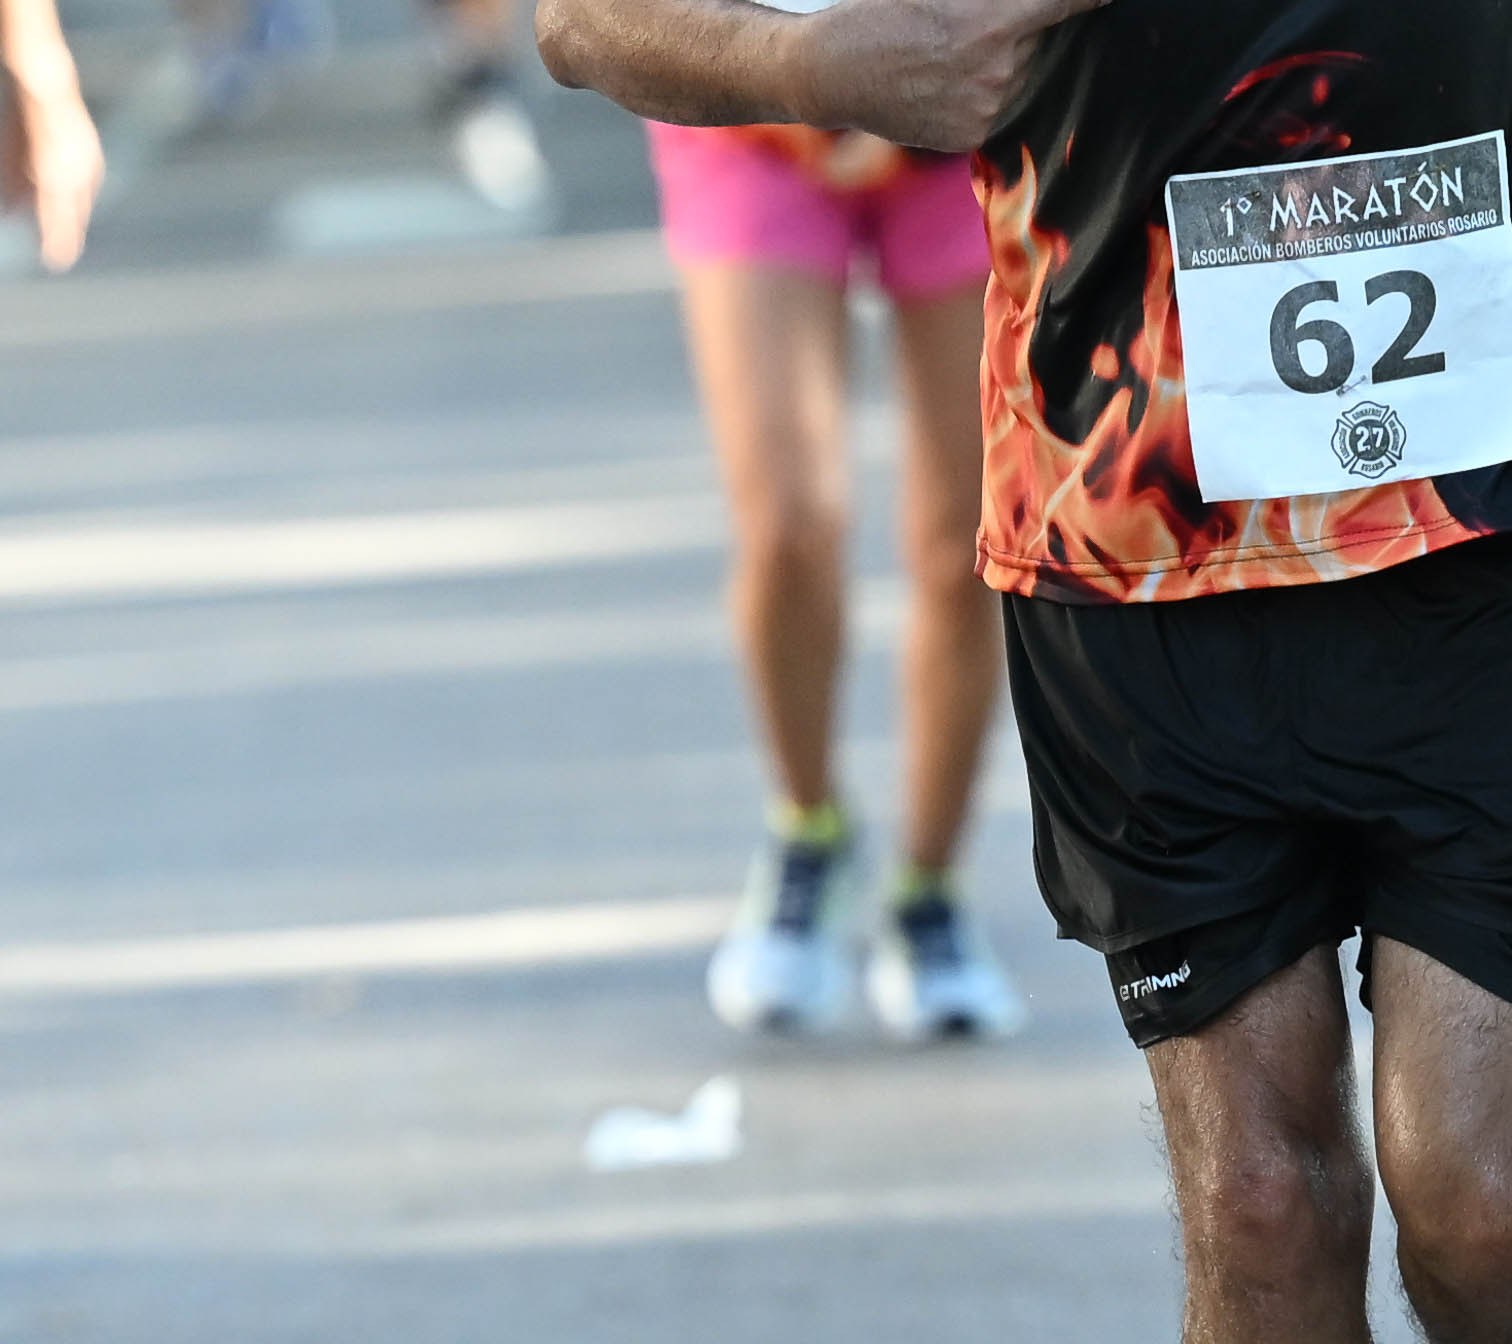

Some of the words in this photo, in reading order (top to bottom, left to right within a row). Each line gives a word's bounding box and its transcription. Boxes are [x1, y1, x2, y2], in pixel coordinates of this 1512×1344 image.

[1269, 161, 1465, 232] MARATÓN
[1191, 240, 1272, 267] ASOCIACIÓN
[1275, 234, 1353, 258] BOMBEROS
[1355, 219, 1447, 249] VOLUNTARIOS
[1448, 208, 1498, 233] ROSARIO
[1269, 269, 1446, 395] 62
[1355, 425, 1384, 454] 27
